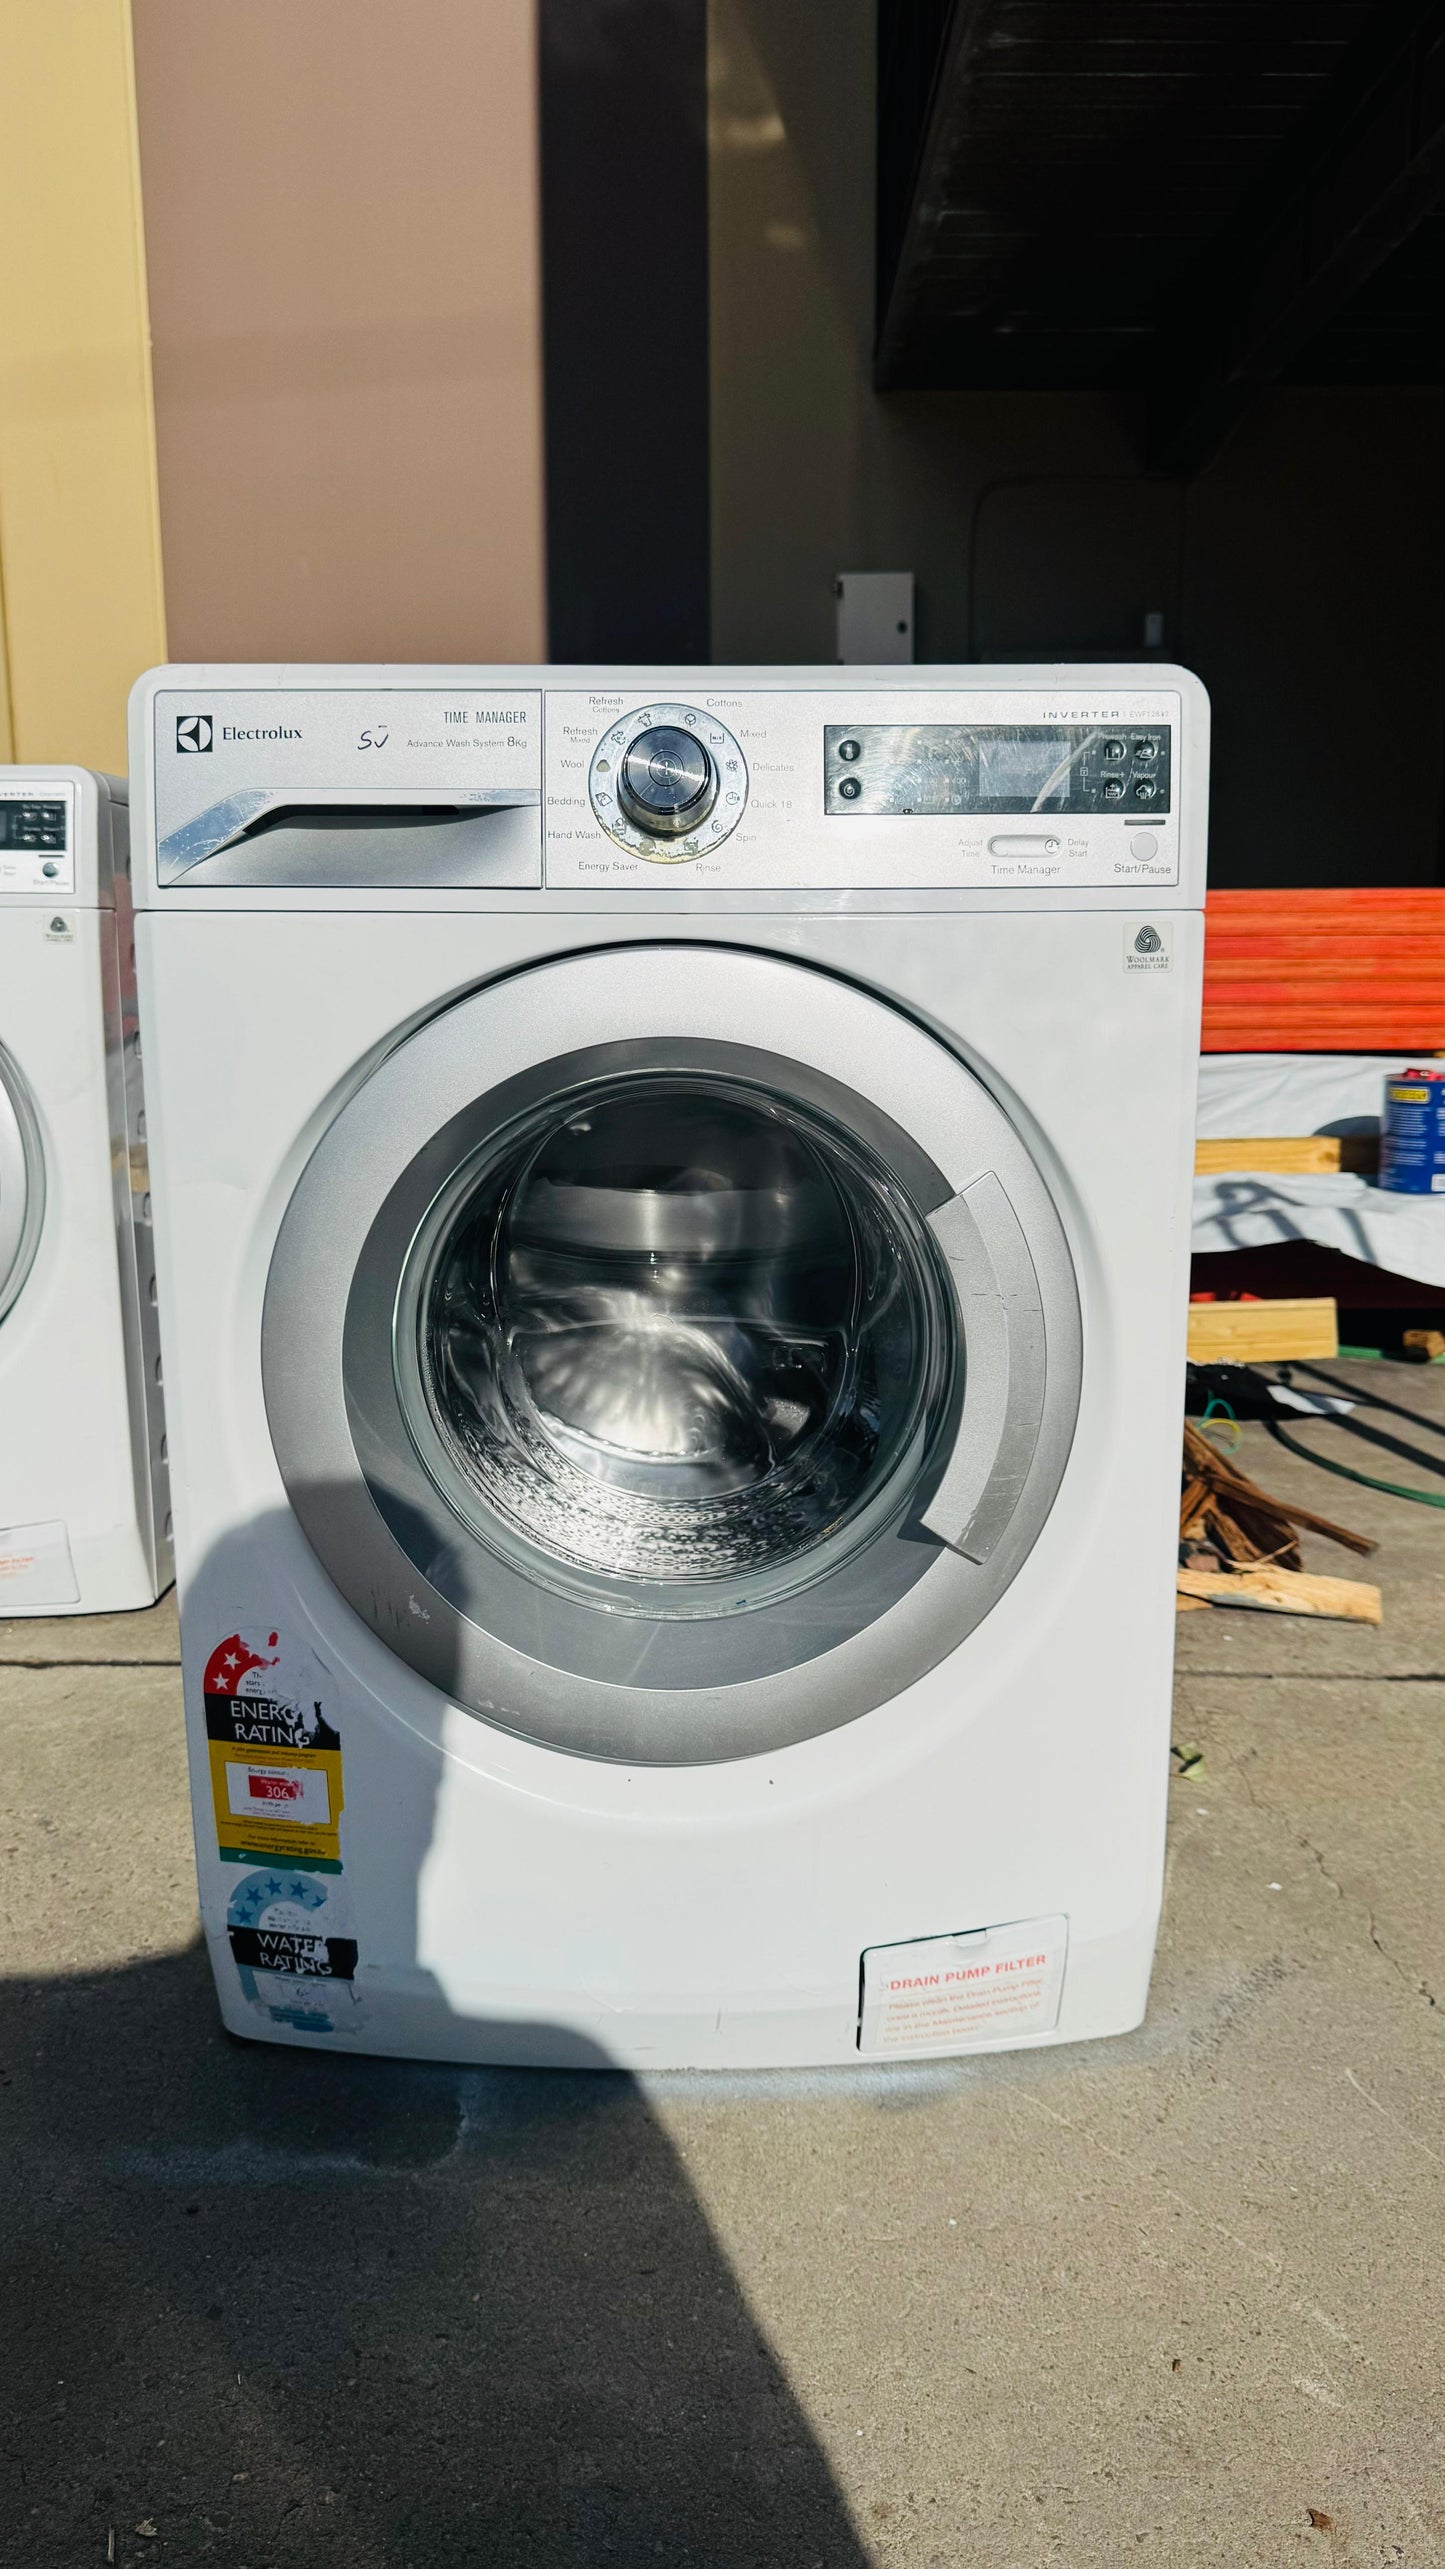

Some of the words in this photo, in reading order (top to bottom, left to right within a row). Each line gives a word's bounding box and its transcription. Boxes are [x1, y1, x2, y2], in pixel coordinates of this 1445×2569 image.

[588, 696, 624, 706] Refresh
[706, 698, 743, 708] Cottons
[444, 711, 469, 724] TIME
[476, 711, 527, 724] MANAGER
[1043, 711, 1120, 719] INVERTER
[223, 726, 303, 740] Electrolux
[563, 727, 598, 736] Refresh
[740, 730, 767, 739] Mixed
[407, 739, 444, 748] Advance
[446, 739, 471, 748] Wash
[472, 739, 505, 749] System
[561, 760, 585, 769] Wool
[752, 763, 795, 772] Delicates
[547, 797, 586, 807] Bedding
[751, 800, 778, 809] Quick
[781, 799, 793, 809] 18
[548, 831, 573, 840] Hand
[575, 831, 601, 840] Wash
[736, 833, 757, 843] Spin
[958, 839, 983, 848] Adjust
[1068, 839, 1089, 847] Delay
[578, 862, 611, 872] Energy
[612, 862, 639, 871] Saver
[696, 864, 721, 873] Rinse
[992, 865, 1015, 875] Time
[1017, 865, 1061, 876] Manager
[1113, 863, 1171, 875] Start/Pause
[235, 1723, 310, 1747] RATING
[266, 1785, 290, 1799] 306
[260, 1952, 333, 1975] RATING
[890, 1974, 940, 1990] DRAIN
[945, 1965, 991, 1983] PUMP
[996, 1954, 1046, 1974] FILTER
